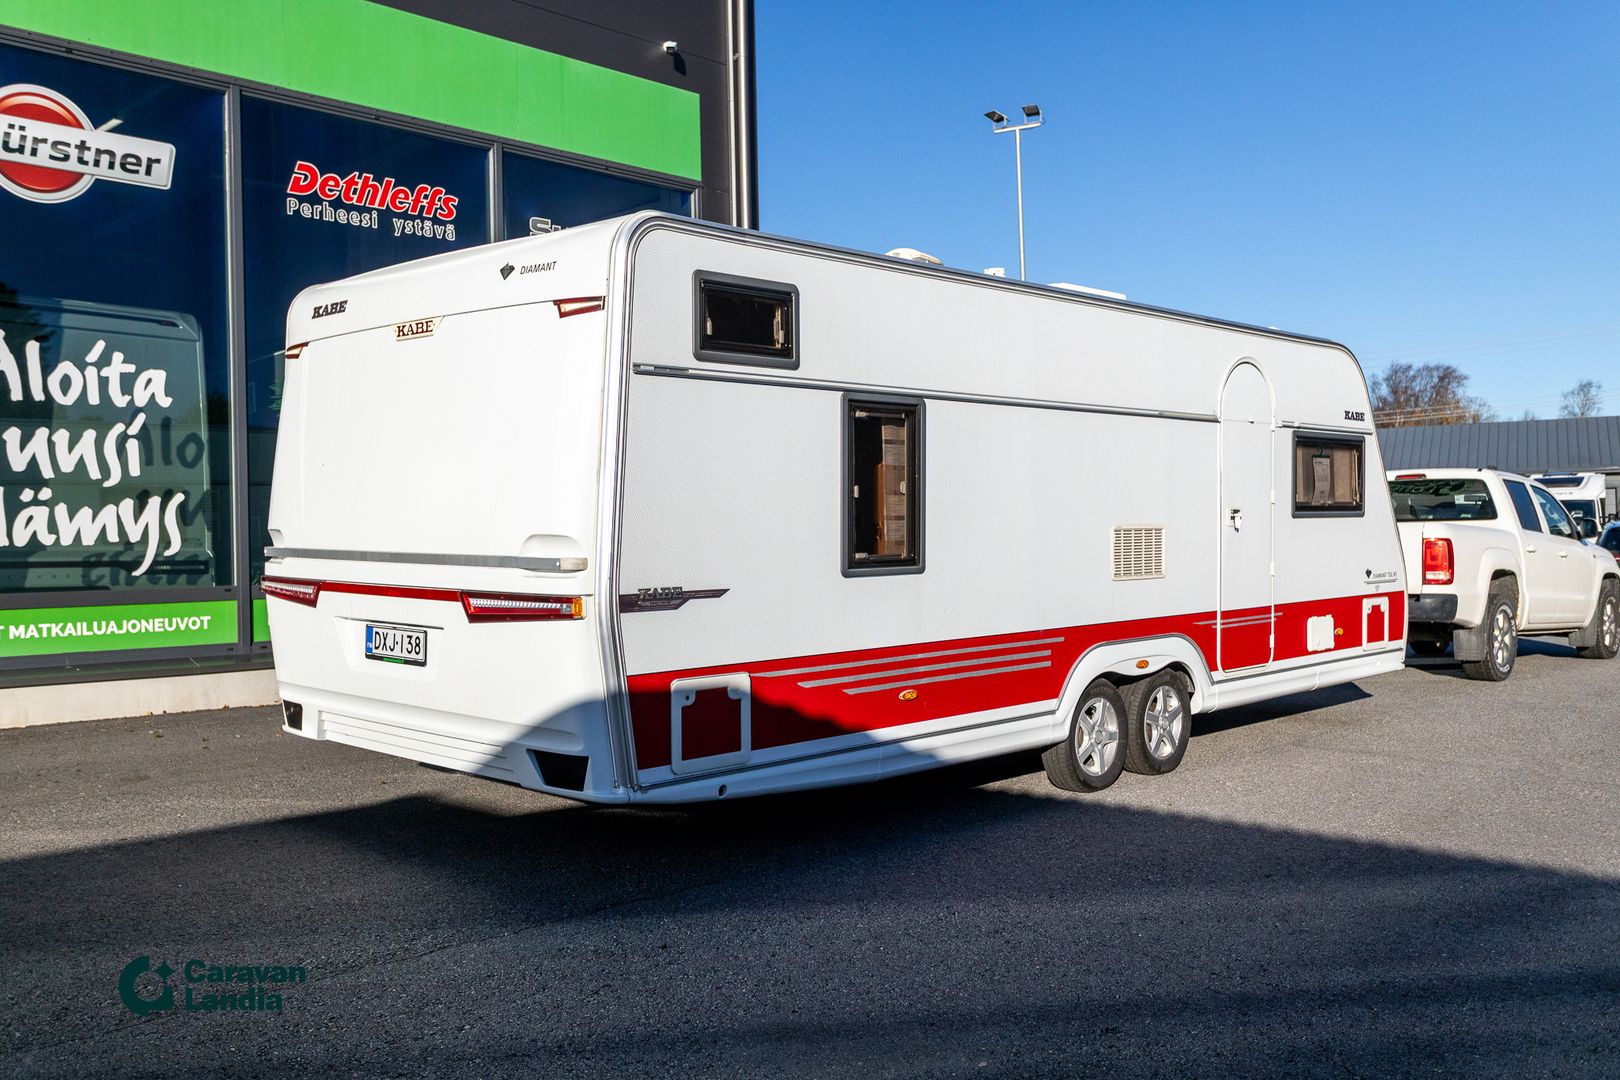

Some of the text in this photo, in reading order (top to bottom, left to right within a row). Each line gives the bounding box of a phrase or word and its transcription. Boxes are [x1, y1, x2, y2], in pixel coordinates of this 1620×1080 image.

[287, 161, 458, 220] Dethleffs
[287, 198, 456, 241] Perheesi ystävä
[520, 261, 557, 275] DIAMANT
[311, 300, 348, 319] KABE
[396, 320, 434, 338] KABE
[1344, 410, 1365, 422] KABE
[638, 586, 682, 601] KABE
[9, 616, 211, 639] MATKAILUAJONEUVOT
